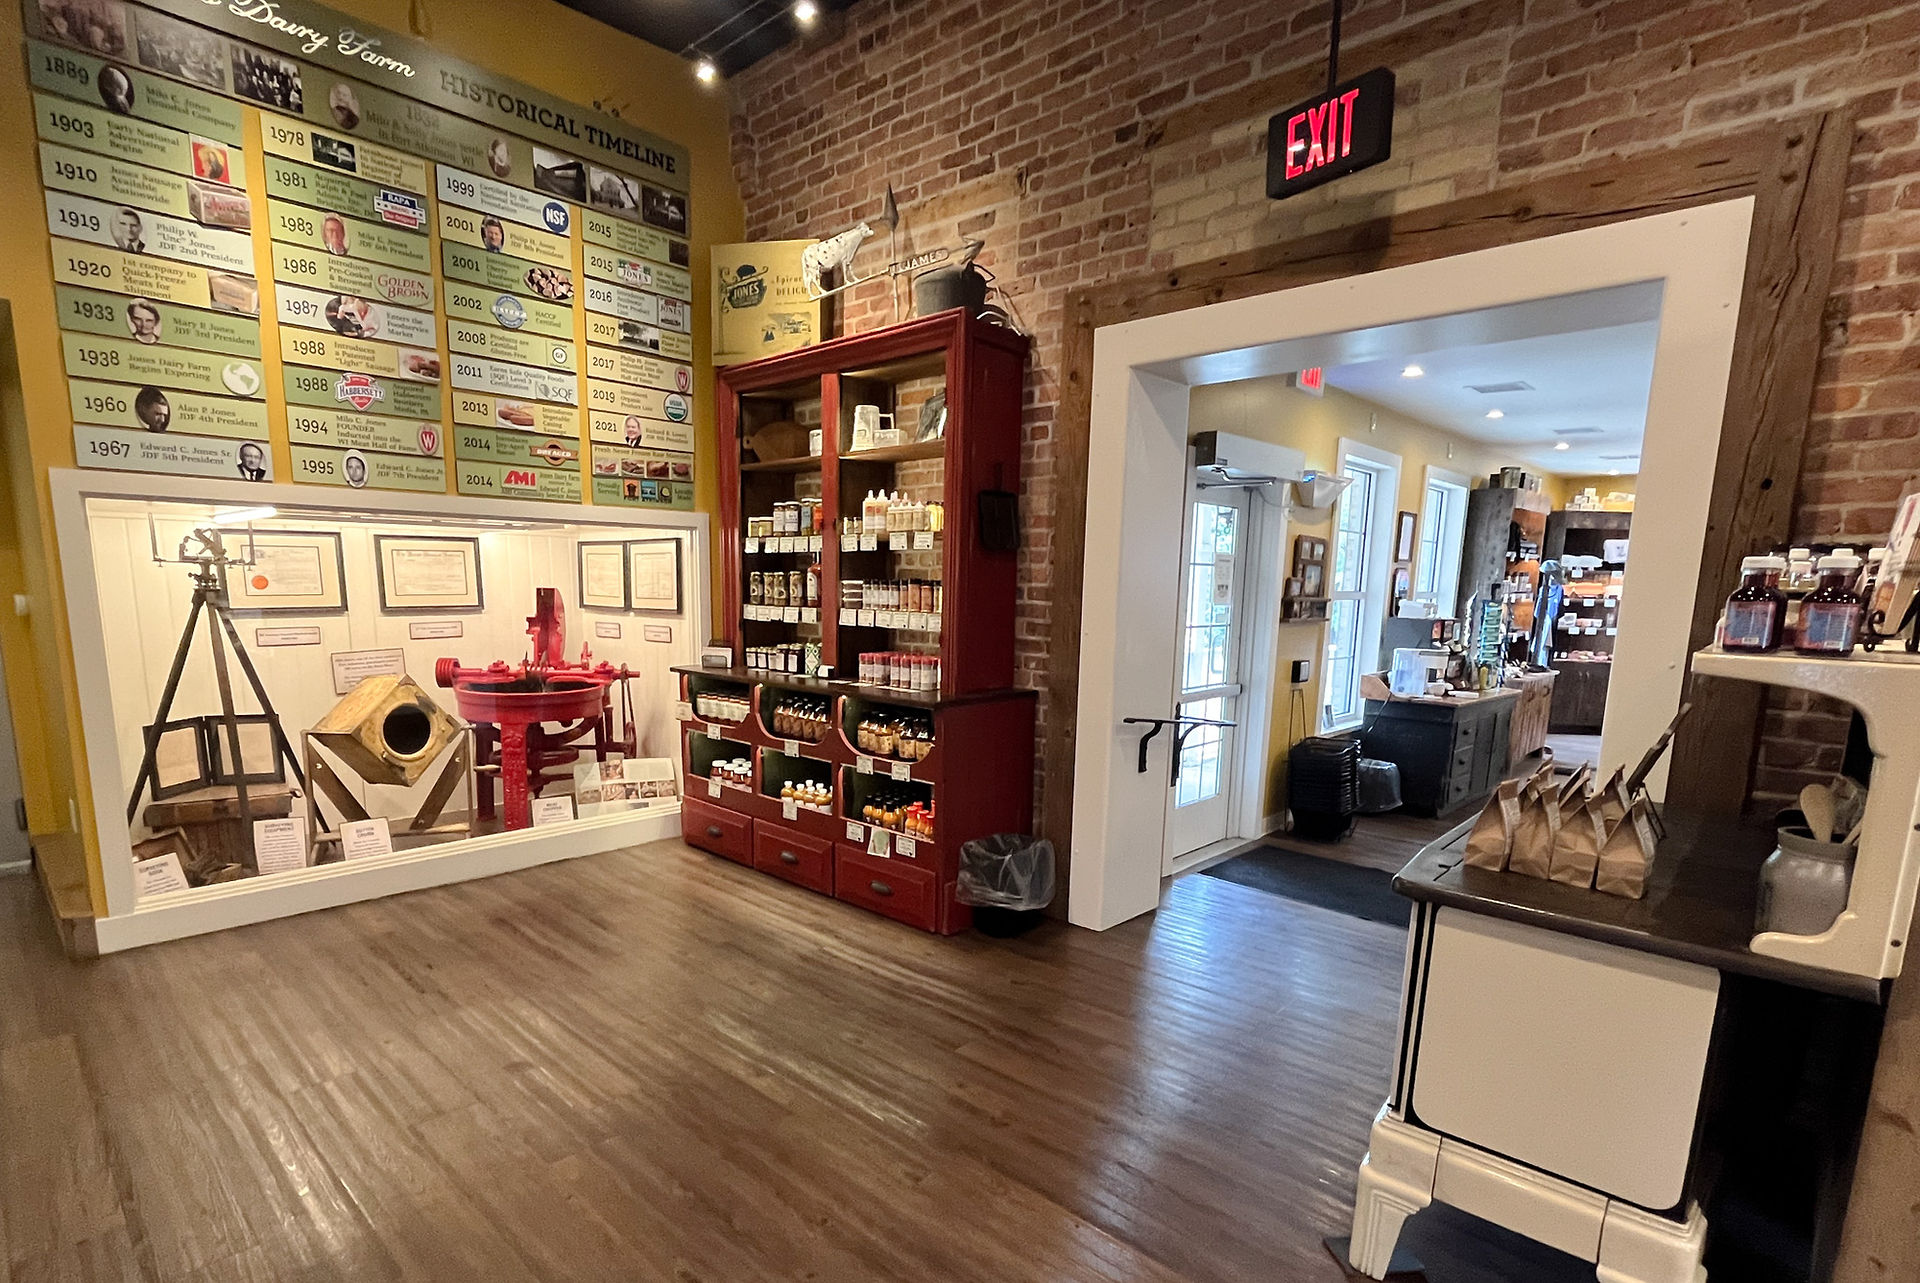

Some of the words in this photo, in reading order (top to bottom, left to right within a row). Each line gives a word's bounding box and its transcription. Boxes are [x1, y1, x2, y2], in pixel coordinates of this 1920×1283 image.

[228, 0, 329, 53] Dairy
[337, 28, 416, 79] Farm
[45, 55, 89, 85] 1889
[185, 98, 212, 114] Jones
[50, 112, 95, 139] 1903
[191, 109, 237, 131] Company
[439, 69, 581, 140] HISTORICAL
[584, 123, 676, 174] TIMELINE
[106, 120, 133, 134] Early
[137, 127, 180, 147] National
[108, 130, 167, 154] Advertising
[270, 126, 305, 147] 1978
[1285, 88, 1360, 180] EXIT
[109, 138, 144, 155] Begins
[55, 161, 97, 183] 1910
[275, 169, 308, 190] 1981
[111, 175, 158, 193] Available
[142, 173, 183, 190] Sausage
[446, 177, 475, 198] 1999
[112, 185, 171, 204] Nationwide
[387, 194, 411, 207] RAPA
[59, 208, 101, 232] 1919
[446, 215, 475, 234] 2001
[546, 207, 566, 226] NSF
[155, 223, 186, 238] Philip
[280, 215, 314, 237] 1983
[589, 220, 612, 238] 2015
[156, 231, 187, 246] "Unc"
[189, 238, 216, 251] Jones
[357, 231, 375, 241] Milo
[387, 238, 408, 249] Jones
[157, 241, 177, 253] JDF
[179, 246, 198, 256] 2nd
[200, 251, 244, 266] President
[389, 246, 425, 261] President
[535, 245, 564, 260] President
[68, 257, 112, 278] 1920
[122, 256, 137, 267] 1st
[139, 260, 184, 277] company
[186, 269, 197, 279] to
[282, 257, 317, 276] 1986
[327, 257, 370, 273] Introduces
[451, 255, 480, 272] 2001
[590, 255, 613, 273] 2015
[121, 266, 187, 286] Quick-Freeze
[328, 265, 373, 281] Pre-Cooked
[624, 269, 649, 283] JONES
[122, 275, 152, 288] Meats
[155, 281, 171, 291] for
[329, 281, 361, 294] Sausage
[377, 274, 425, 291] GOLDEN
[732, 282, 760, 300] JONES
[123, 284, 172, 301] Shipment
[387, 286, 430, 301] BROWN
[589, 288, 613, 303] 2016
[285, 298, 319, 318] 1987
[453, 294, 483, 311] 2002
[73, 300, 114, 323] 1933
[386, 311, 410, 323] Enters
[411, 316, 423, 325] the
[172, 317, 197, 329] Mary
[209, 322, 235, 334] Jones
[387, 320, 430, 334] Foodservice
[535, 318, 562, 329] Certified
[593, 322, 616, 338] 2017
[174, 326, 192, 335] JDF
[194, 330, 211, 339] 3rd
[213, 333, 256, 346] President
[387, 327, 414, 339] Market
[457, 330, 486, 345] 2008
[489, 333, 518, 344] Products
[292, 340, 325, 356] 1988
[334, 341, 376, 355] Introduces
[489, 340, 518, 351] Certified
[490, 347, 527, 359] Gluten-Free
[79, 348, 120, 368] 1938
[127, 354, 156, 365] Jones
[158, 358, 185, 371] Dairy
[187, 361, 212, 372] Farm
[335, 357, 363, 367] "Light"
[365, 362, 396, 373] Sausage
[341, 351, 376, 362] Patented
[592, 356, 615, 371] 2017
[128, 363, 162, 377] Begins
[163, 368, 211, 382] Exporting
[456, 364, 483, 378] 2011
[508, 367, 522, 376] Safe
[523, 371, 546, 381] Quality
[547, 375, 565, 383] Foods
[295, 377, 329, 392] 1988
[339, 384, 382, 399] HABBERSETT
[489, 379, 529, 391] Certification
[551, 386, 574, 401] SQF
[592, 389, 616, 403] 2019
[84, 395, 127, 413] 1960
[177, 402, 199, 413] Alan
[211, 407, 237, 418] Jones
[462, 400, 489, 416] 2013
[179, 412, 197, 422] JDF
[198, 414, 214, 424] 4th
[216, 415, 259, 428] President
[295, 418, 329, 435] 1994
[335, 414, 354, 424] Milo
[365, 418, 387, 428] Jones
[542, 413, 571, 423] Vegetable
[595, 420, 618, 433] 2021
[336, 422, 376, 433] FOUNDER
[336, 430, 372, 440] Inducted
[372, 433, 388, 442] into
[389, 435, 402, 443] the
[337, 437, 349, 445] WI
[350, 439, 370, 448] Meat
[371, 440, 387, 450] Hall
[388, 442, 397, 450] of
[398, 444, 418, 452] Fame
[421, 432, 435, 451] W
[463, 437, 491, 451] 2014
[90, 440, 131, 459] 1967
[139, 441, 177, 454] Edward
[179, 444, 190, 454] C.
[191, 446, 219, 457] Jones
[219, 448, 232, 458] Sr.
[140, 449, 160, 459] JDF
[162, 452, 179, 462] 5th
[181, 453, 225, 466] President
[302, 459, 335, 475] 1995
[375, 462, 404, 473] Edward
[376, 470, 391, 479] JDF
[392, 472, 405, 480] 7th
[406, 472, 440, 481] President
[466, 474, 494, 488] 2014
[503, 469, 537, 487] AMI
